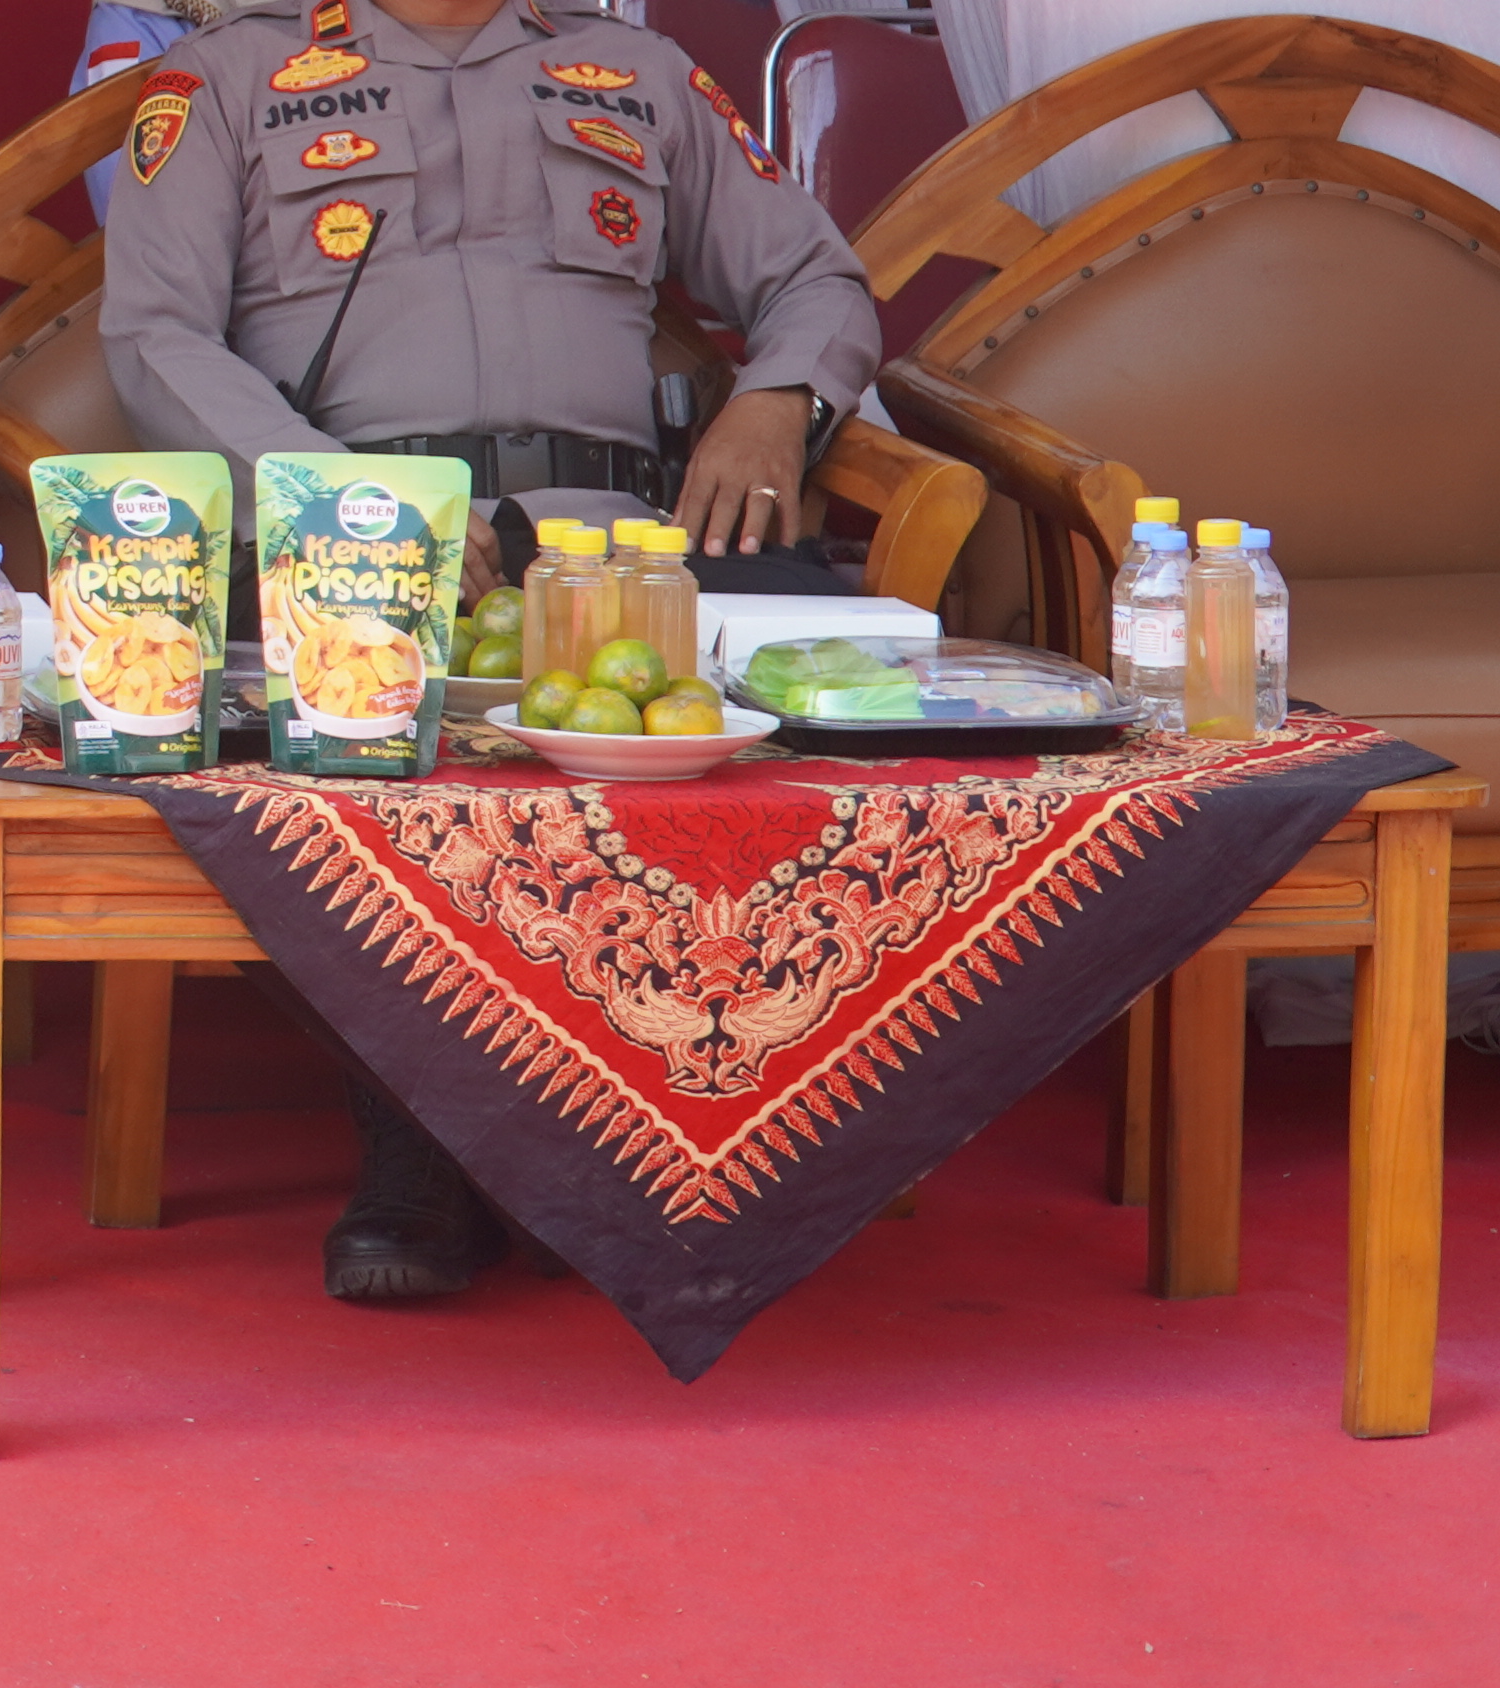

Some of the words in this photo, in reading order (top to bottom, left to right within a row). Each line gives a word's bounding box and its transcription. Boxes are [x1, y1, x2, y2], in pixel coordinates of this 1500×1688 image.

[264, 86, 391, 130] JHONY
[531, 83, 657, 127] POLRI
[89, 533, 200, 566] Keripik
[305, 533, 426, 569] Keripik
[77, 562, 206, 605] Pisang
[294, 561, 433, 611] Pisang
